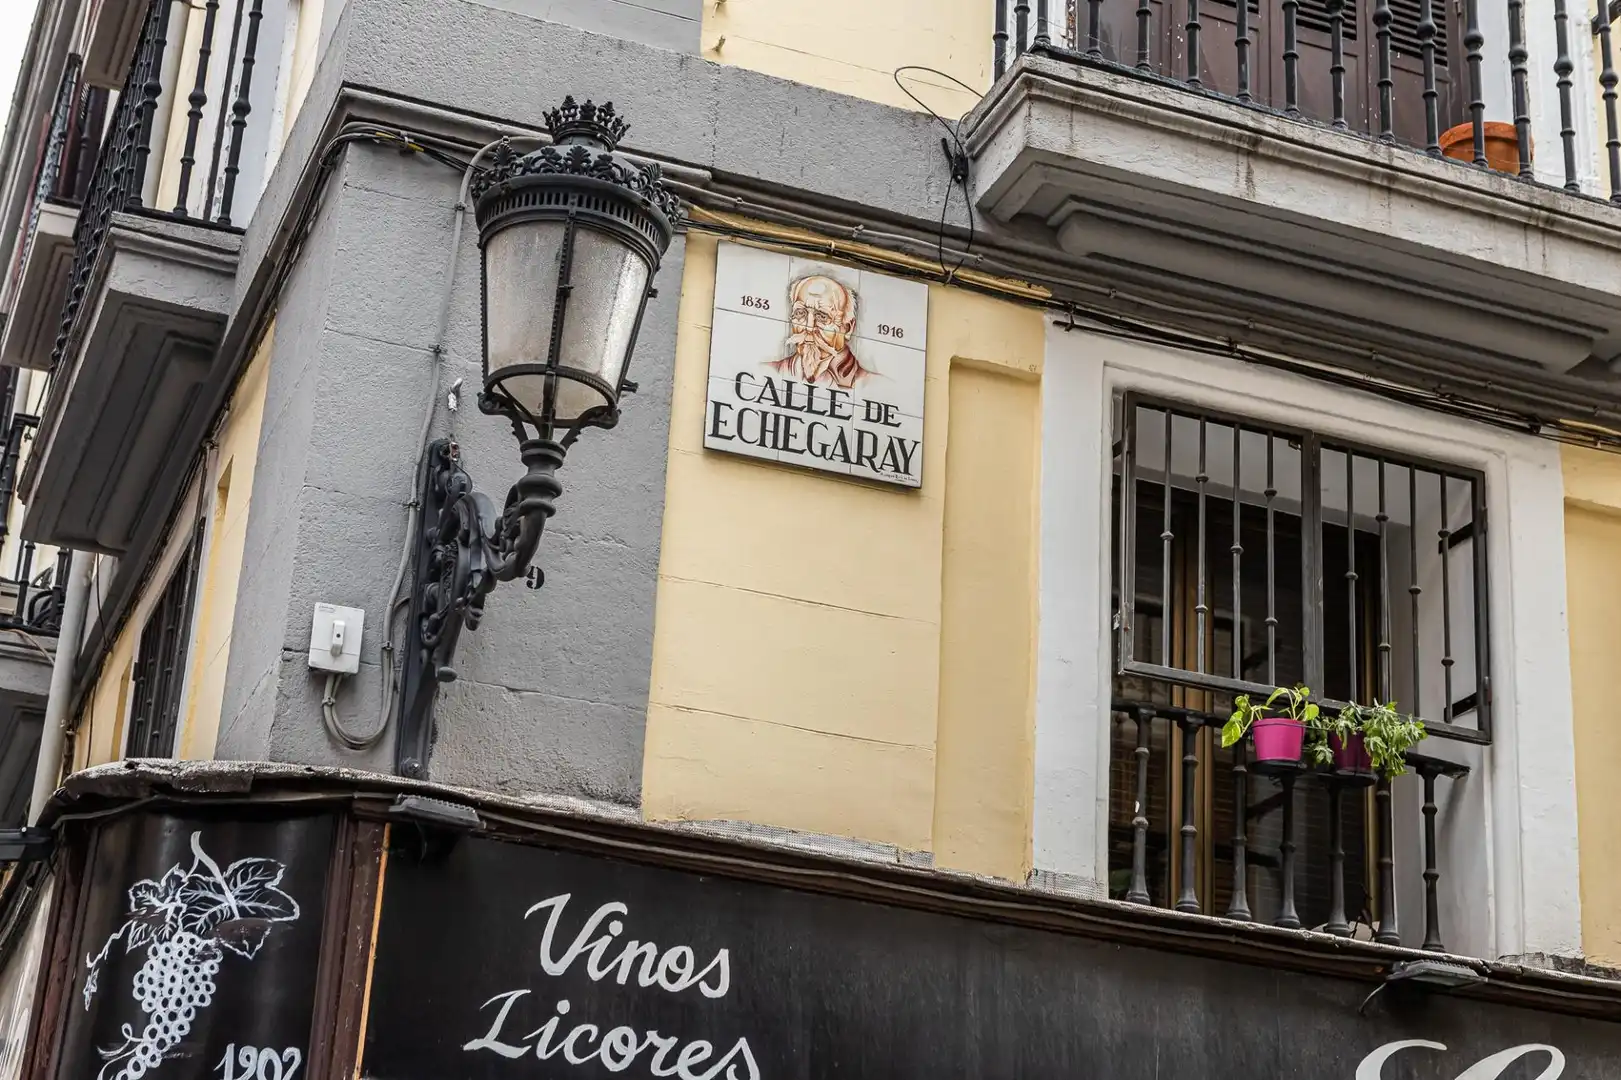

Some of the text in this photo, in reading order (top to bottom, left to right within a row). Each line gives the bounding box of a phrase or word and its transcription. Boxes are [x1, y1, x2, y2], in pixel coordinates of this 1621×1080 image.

[740, 295, 770, 310] 1833
[877, 323, 904, 339] 1916
[735, 371, 902, 427] CALLE DE
[708, 400, 920, 476] ECHEGARAY
[524, 893, 729, 998] Vinos
[464, 989, 760, 1080] Licores
